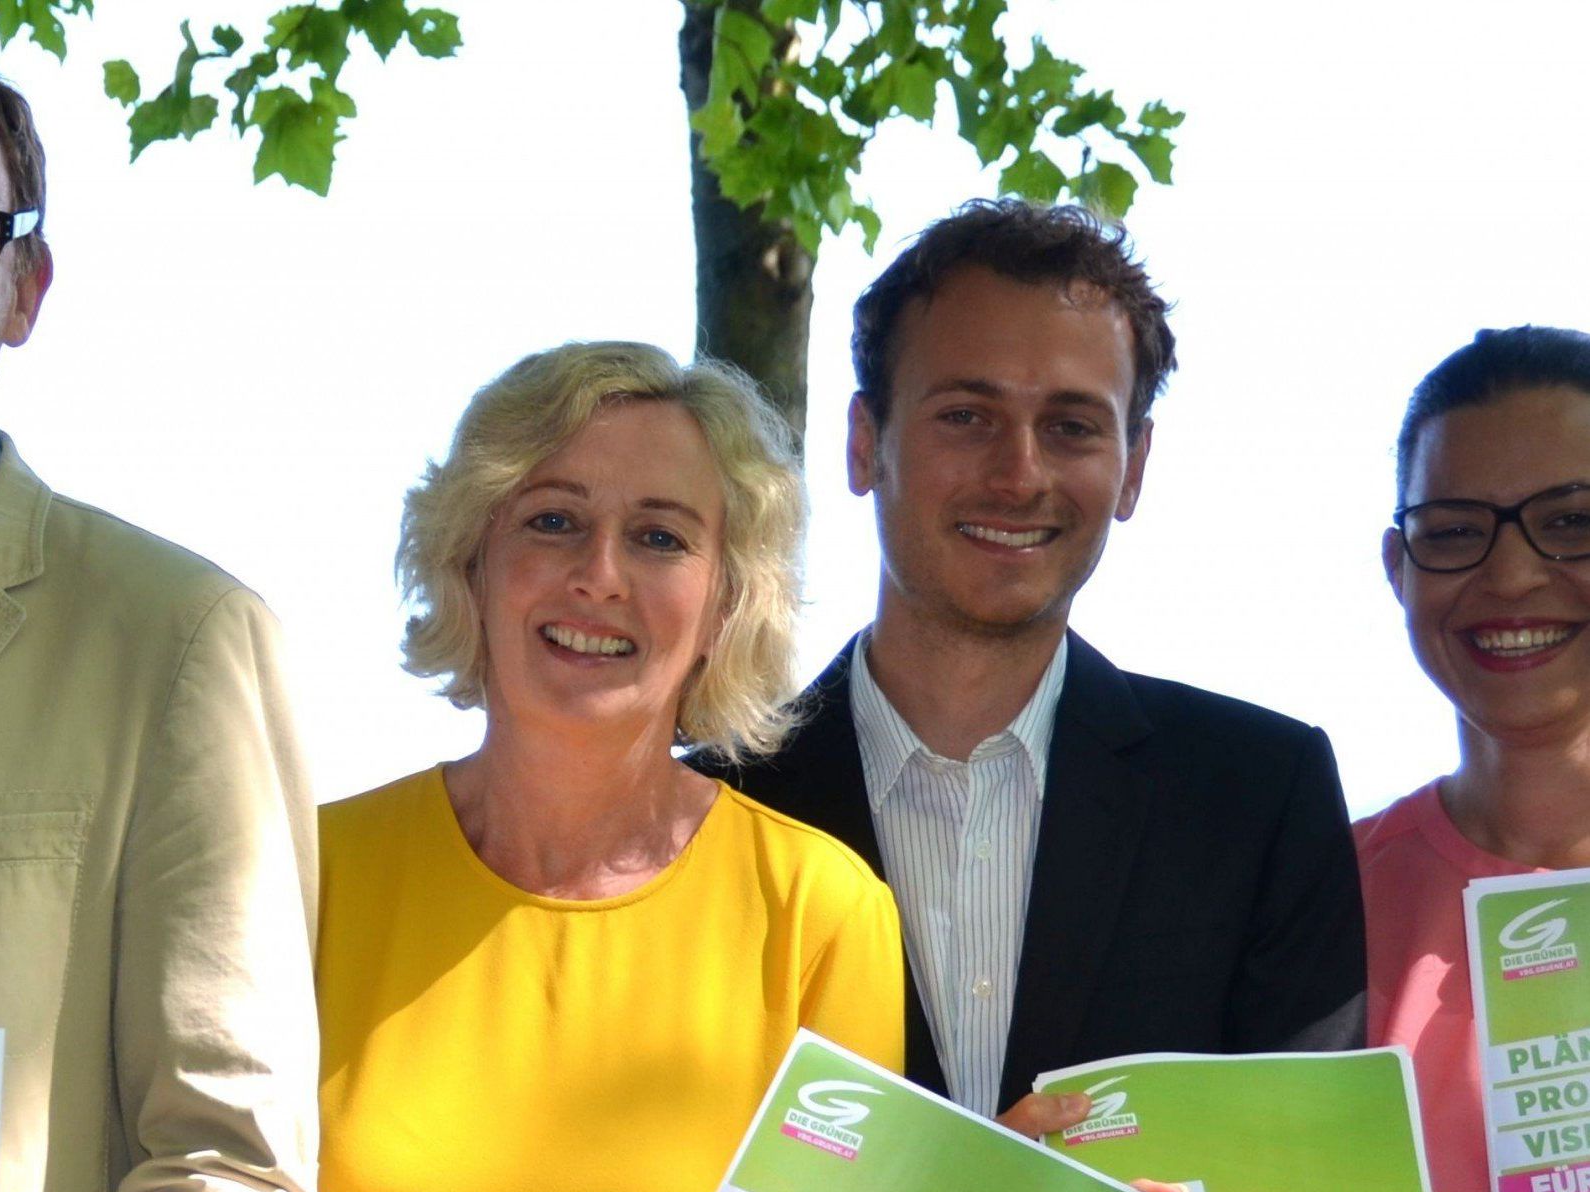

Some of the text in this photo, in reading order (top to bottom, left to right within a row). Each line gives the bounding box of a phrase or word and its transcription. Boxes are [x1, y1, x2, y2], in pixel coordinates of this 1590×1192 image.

[1504, 948, 1573, 967] DIE GRÜNEN
[789, 1111, 860, 1147] DIE GRÜNEN
[1065, 1113, 1134, 1136] DIE GRÜNEN
